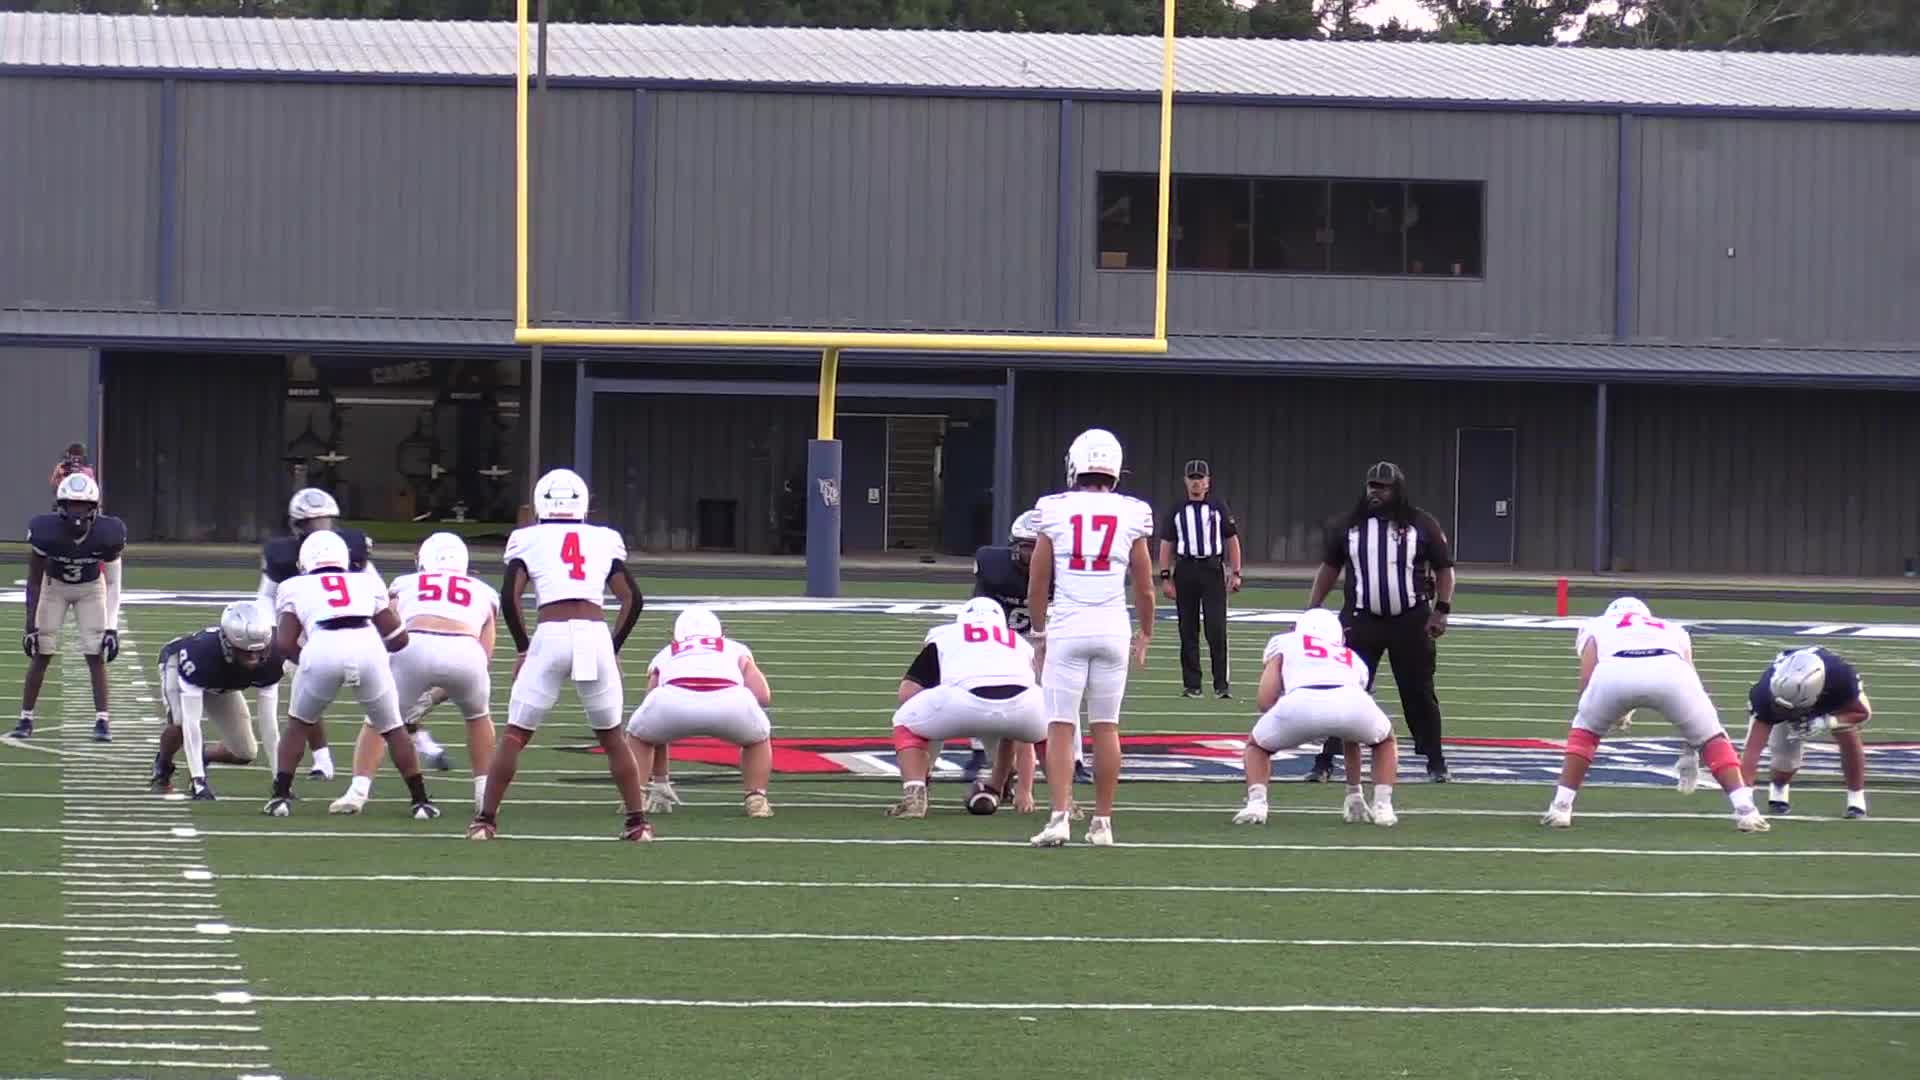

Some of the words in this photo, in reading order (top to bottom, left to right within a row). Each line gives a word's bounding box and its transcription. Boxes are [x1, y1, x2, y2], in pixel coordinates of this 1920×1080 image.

[560, 532, 585, 581] 4
[1069, 514, 1118, 571] 17
[63, 565, 83, 581] 3
[418, 573, 472, 607] 56
[321, 576, 351, 608] 9
[963, 623, 1016, 649] 60
[1303, 634, 1352, 669] 53
